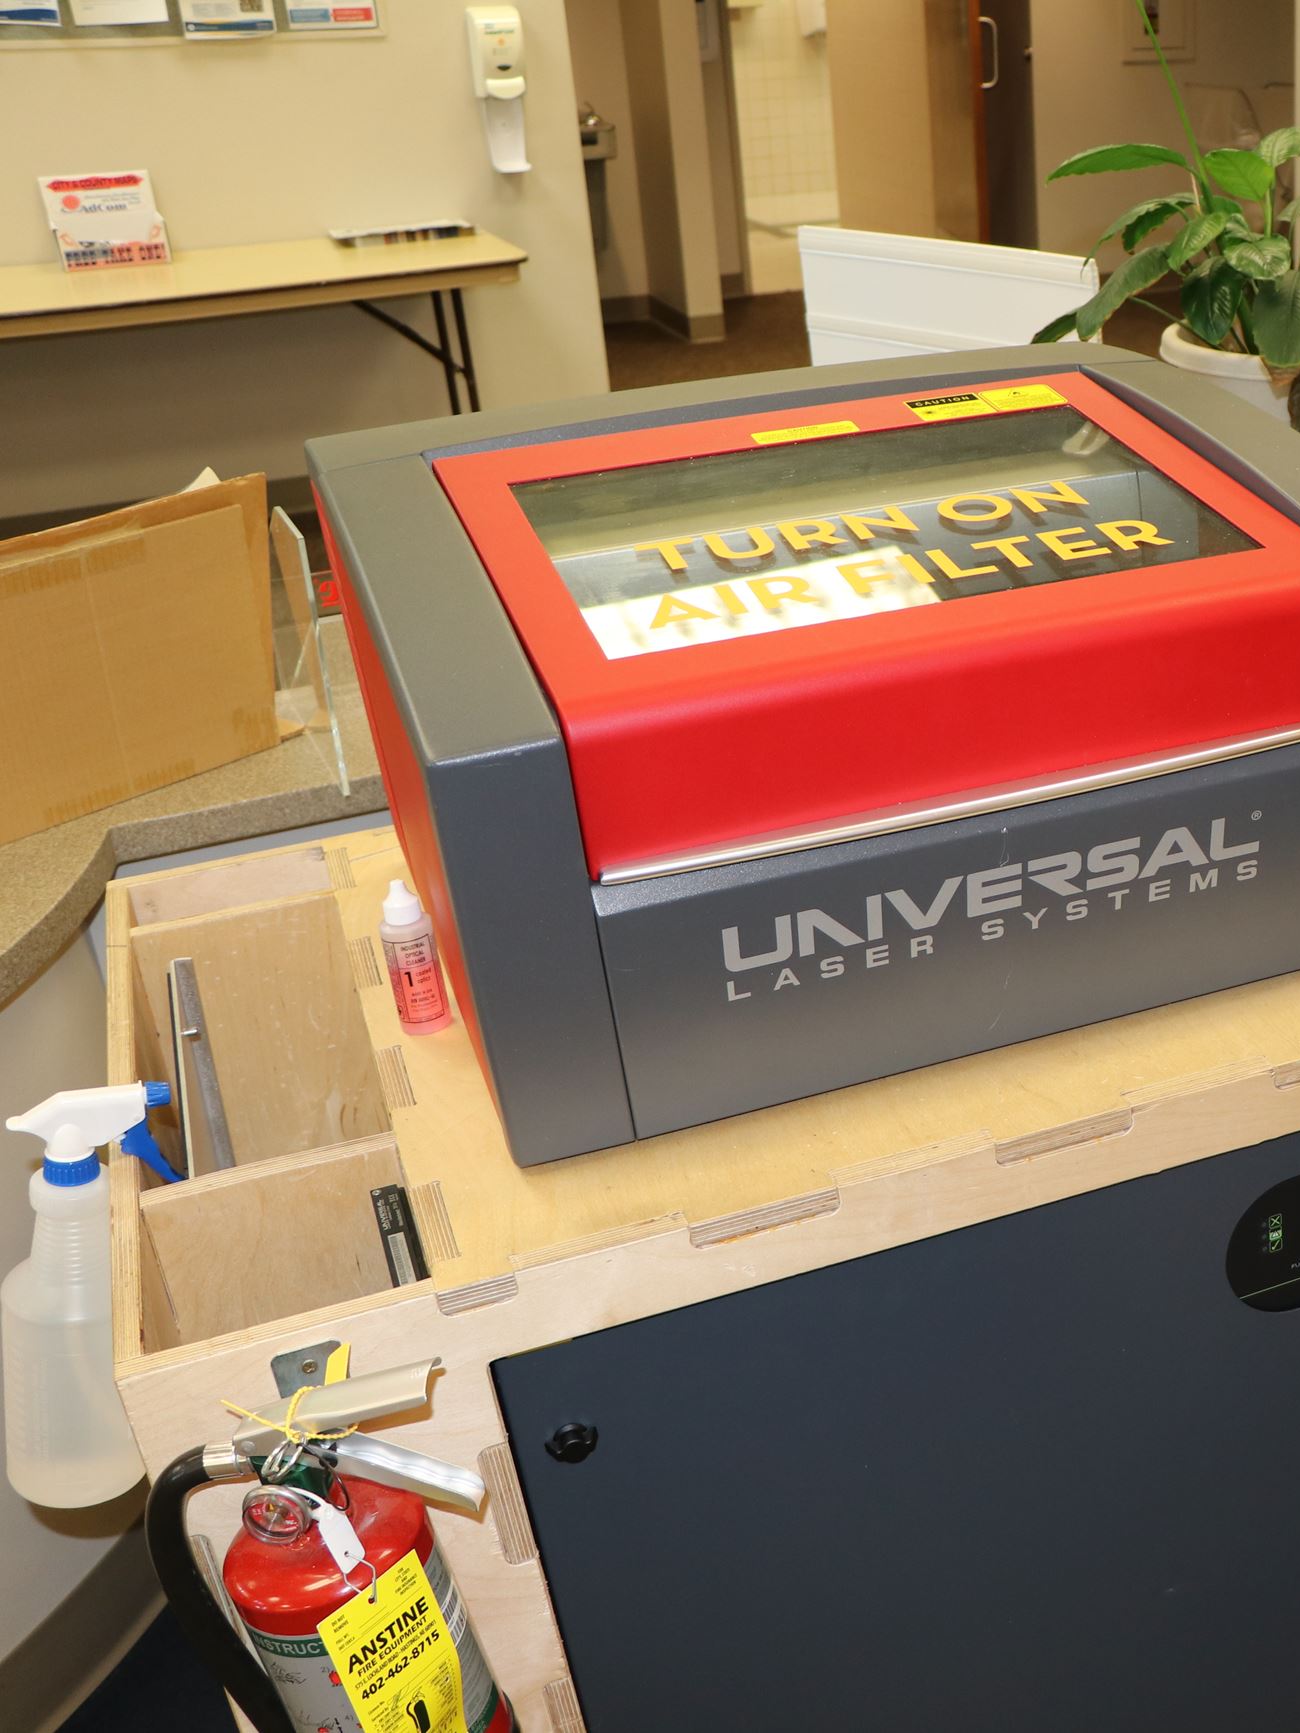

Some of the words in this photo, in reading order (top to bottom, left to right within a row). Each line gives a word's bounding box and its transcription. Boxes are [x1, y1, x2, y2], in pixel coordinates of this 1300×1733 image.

[913, 393, 972, 408] CAUTION
[634, 505, 918, 572] TURN
[937, 480, 1090, 523] ON
[649, 574, 816, 630] AIR
[837, 518, 1176, 597] FILTER
[721, 817, 1260, 973] UNIVERSAL
[405, 950, 425, 959] OPTICAL
[405, 957, 426, 967] CLEANER
[726, 934, 935, 1002] LASER
[981, 858, 1260, 941] SYSTEMS
[404, 971, 414, 988] 1
[348, 1596, 429, 1675] ANSTINE
[357, 1657, 378, 1677] FIRE
[378, 1614, 427, 1660] EQUIPMENT
[362, 1630, 440, 1699] 402-462-8715
[387, 1650, 400, 1664] ROAD
